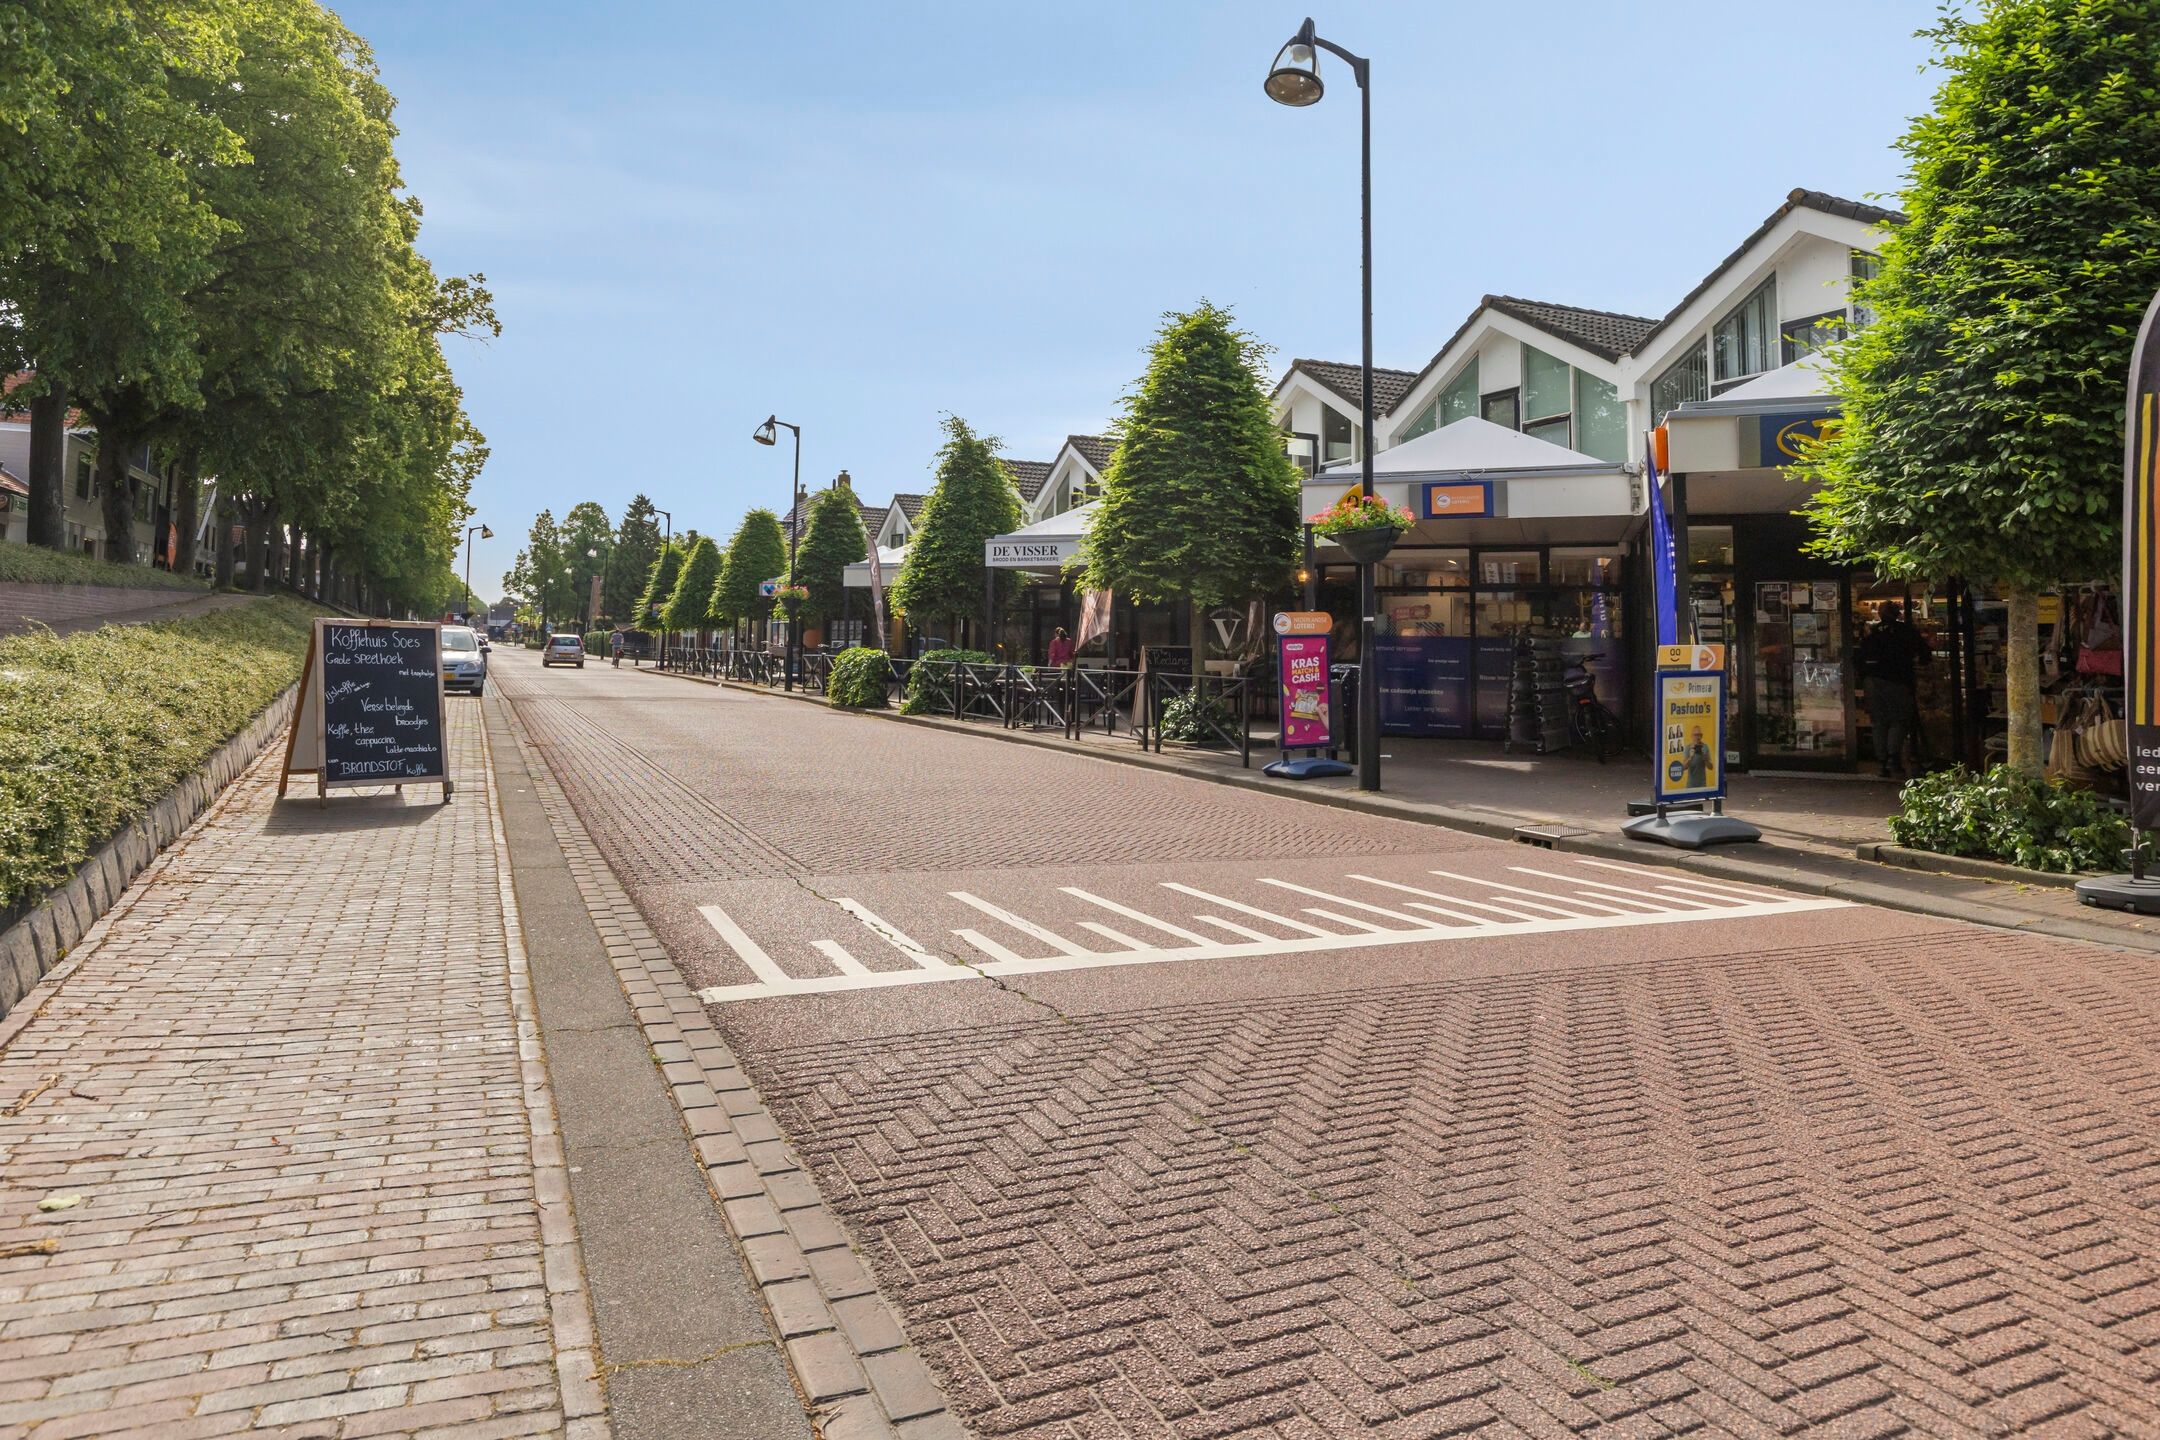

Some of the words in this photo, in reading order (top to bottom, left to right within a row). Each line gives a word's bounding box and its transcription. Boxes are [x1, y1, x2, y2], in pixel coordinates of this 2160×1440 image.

[993, 546, 1010, 556] DE
[1014, 545, 1058, 556] VISSER
[331, 628, 388, 651] Koffiehuis
[392, 630, 420, 648] Soes
[1291, 656, 1320, 670] KRAS
[1292, 667, 1314, 675] MATCH
[1292, 672, 1320, 684] CASH!
[1688, 682, 1712, 694] Primera
[1670, 702, 1711, 715] Pasfoto's
